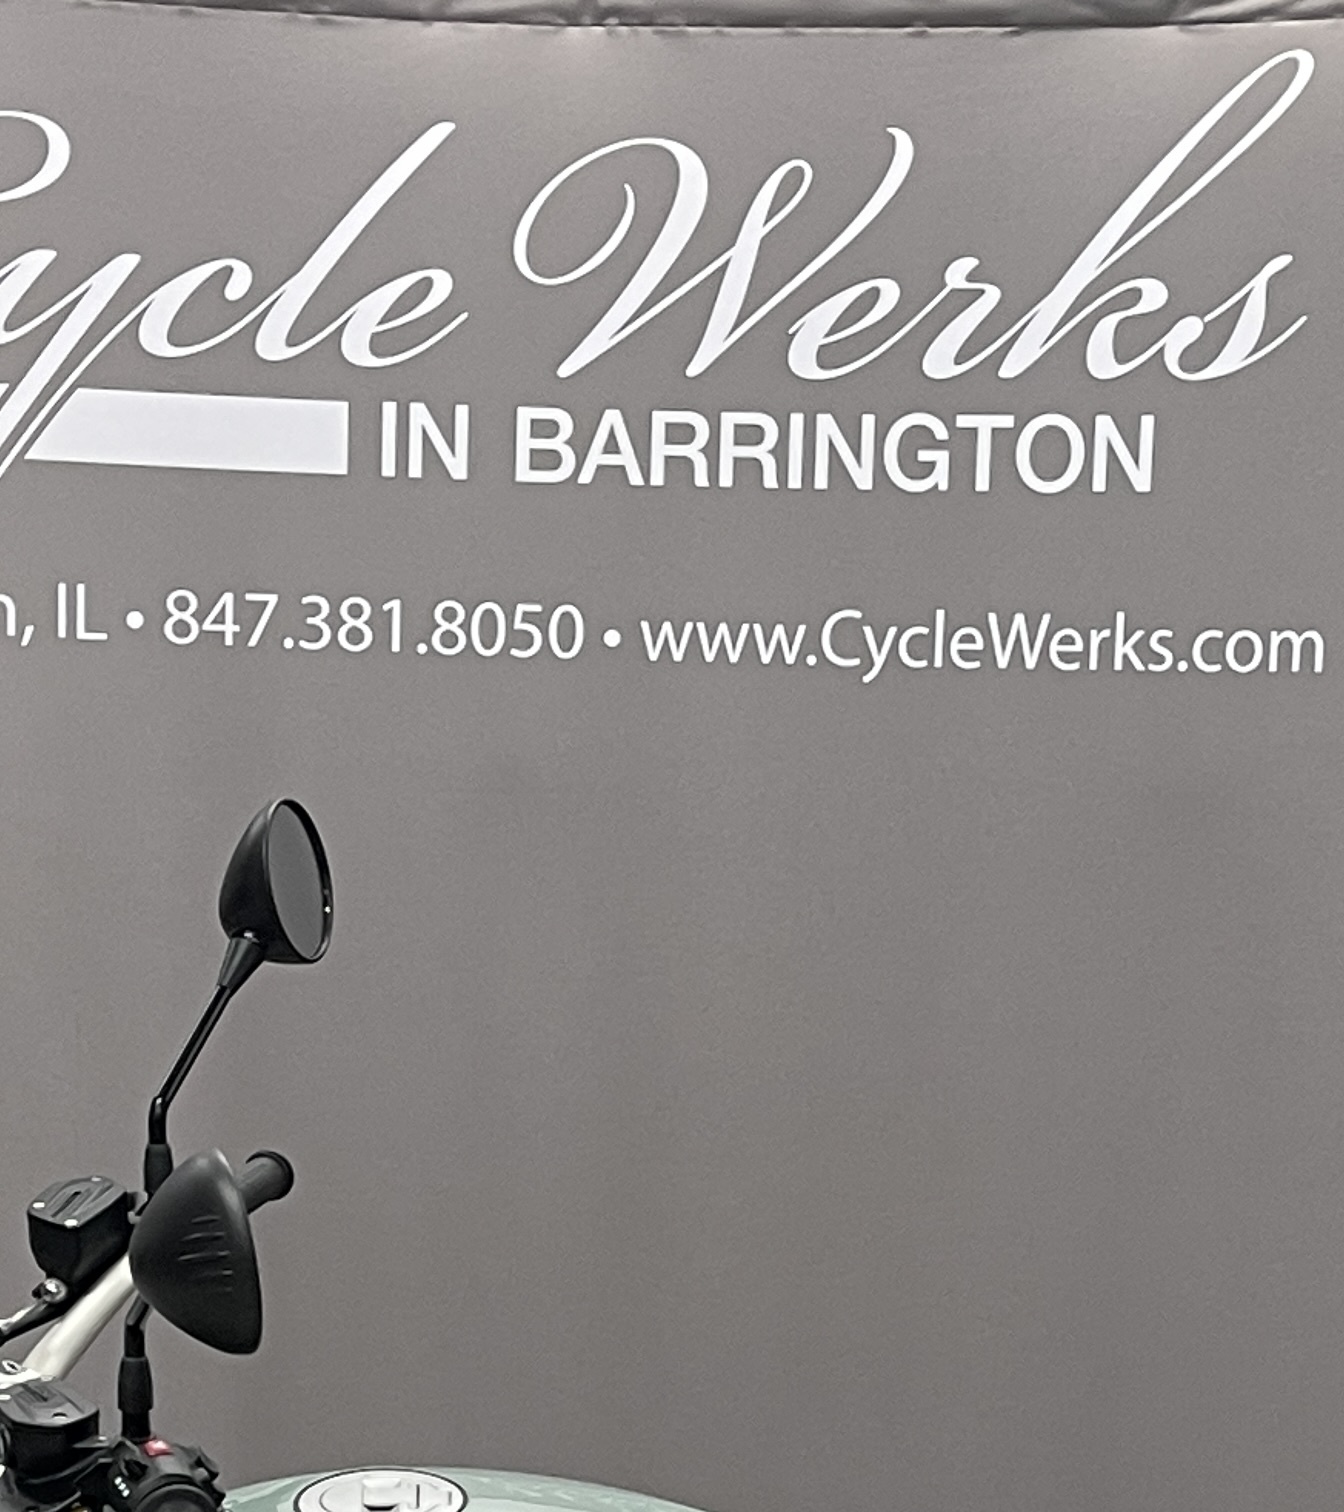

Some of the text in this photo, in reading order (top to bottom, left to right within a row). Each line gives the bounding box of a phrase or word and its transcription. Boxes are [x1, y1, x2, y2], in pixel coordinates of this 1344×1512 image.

[512, 48, 1316, 381] Werks
[381, 400, 1156, 494] IN BARRINGTON
[56, 582, 109, 641] IL
[162, 589, 585, 659] 847.381.8050
[640, 608, 1325, 684] www.CycleWerks.com
